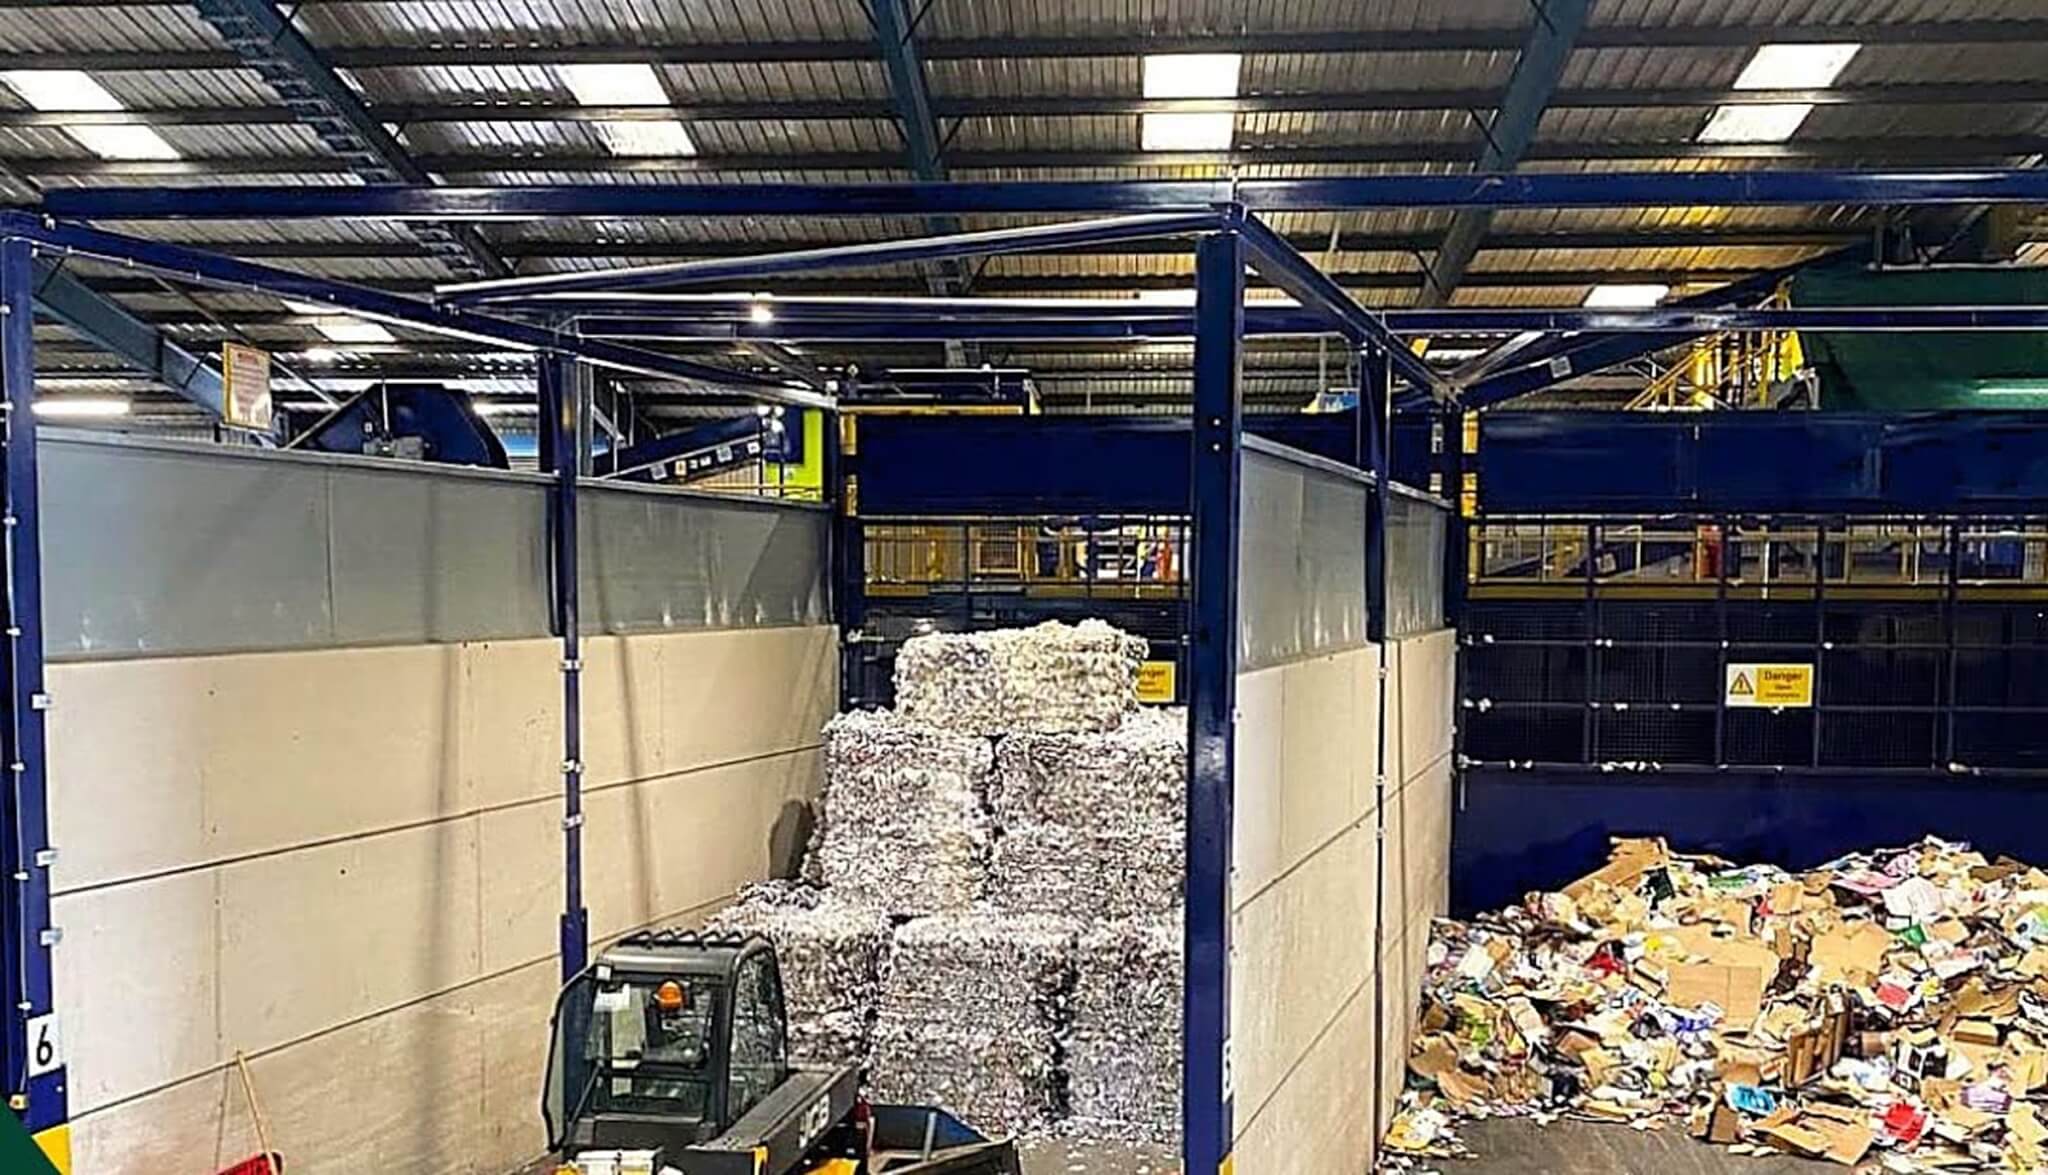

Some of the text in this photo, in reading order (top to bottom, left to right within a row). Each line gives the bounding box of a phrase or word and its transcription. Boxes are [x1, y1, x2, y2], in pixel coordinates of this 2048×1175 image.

[1764, 670, 1802, 682] Danger
[36, 1023, 53, 1067] 6
[799, 1092, 830, 1149] JCB
